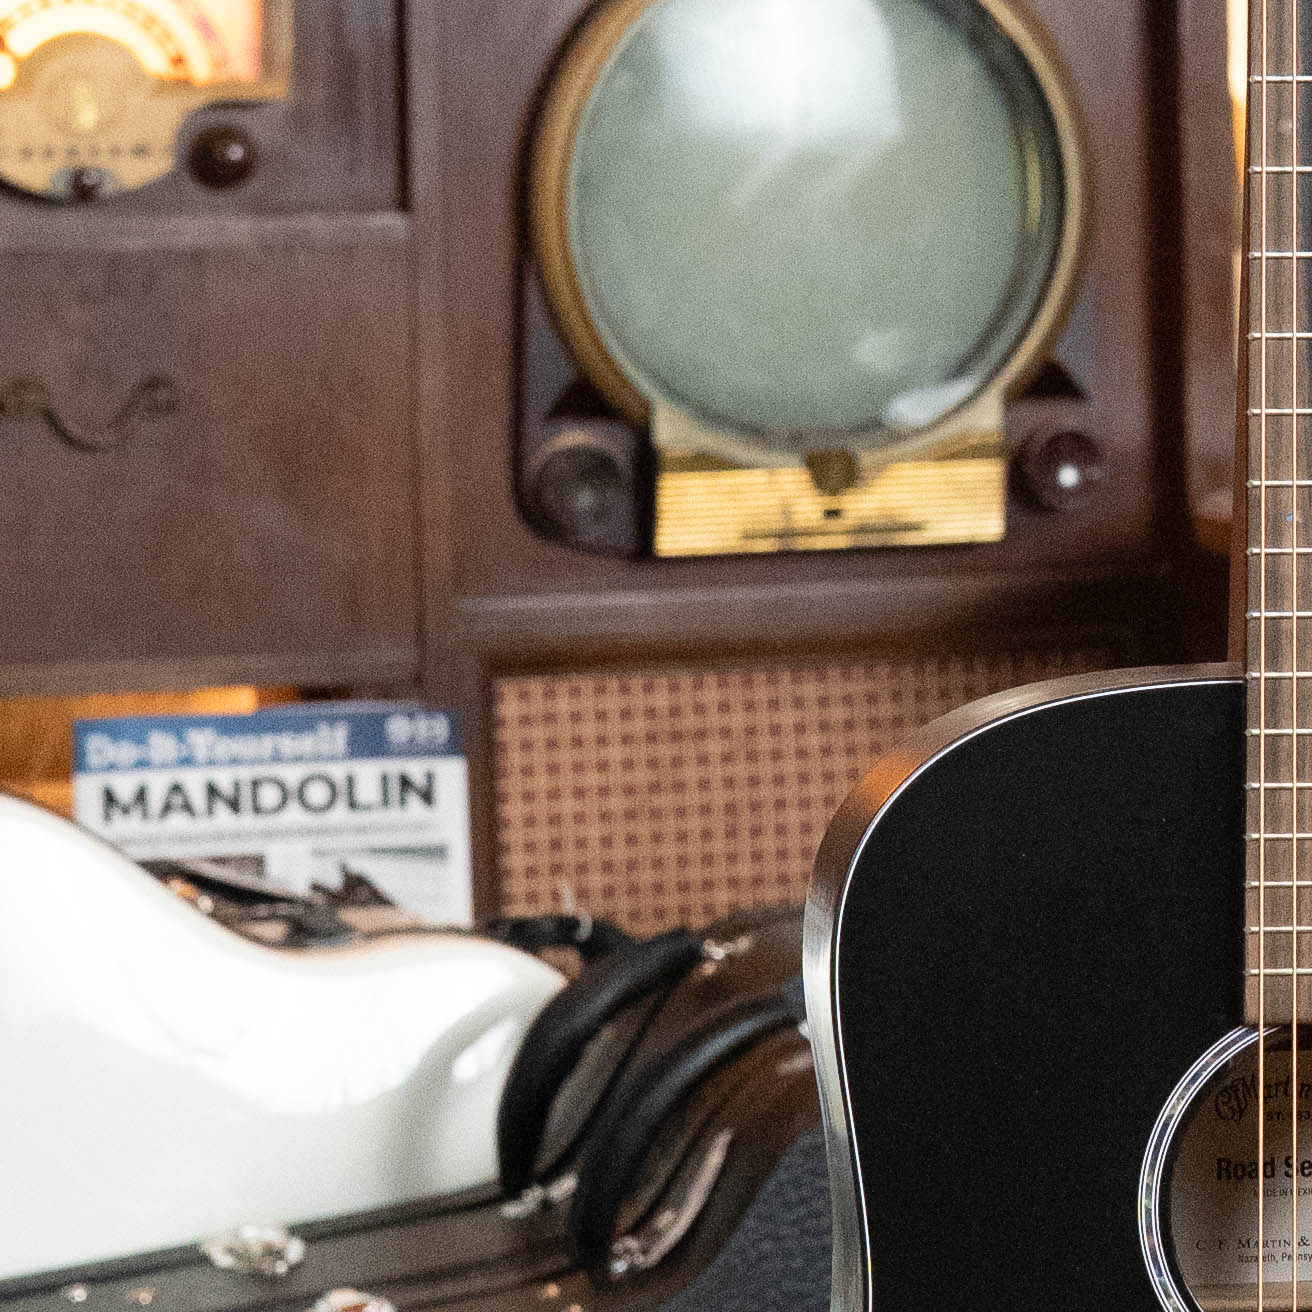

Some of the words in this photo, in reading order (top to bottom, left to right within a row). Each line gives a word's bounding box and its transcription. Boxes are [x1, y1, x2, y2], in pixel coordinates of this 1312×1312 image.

[101, 769, 436, 824] MANDOLIN
[1216, 1157, 1276, 1180] Road
[1298, 1235, 1310, 1247] &
